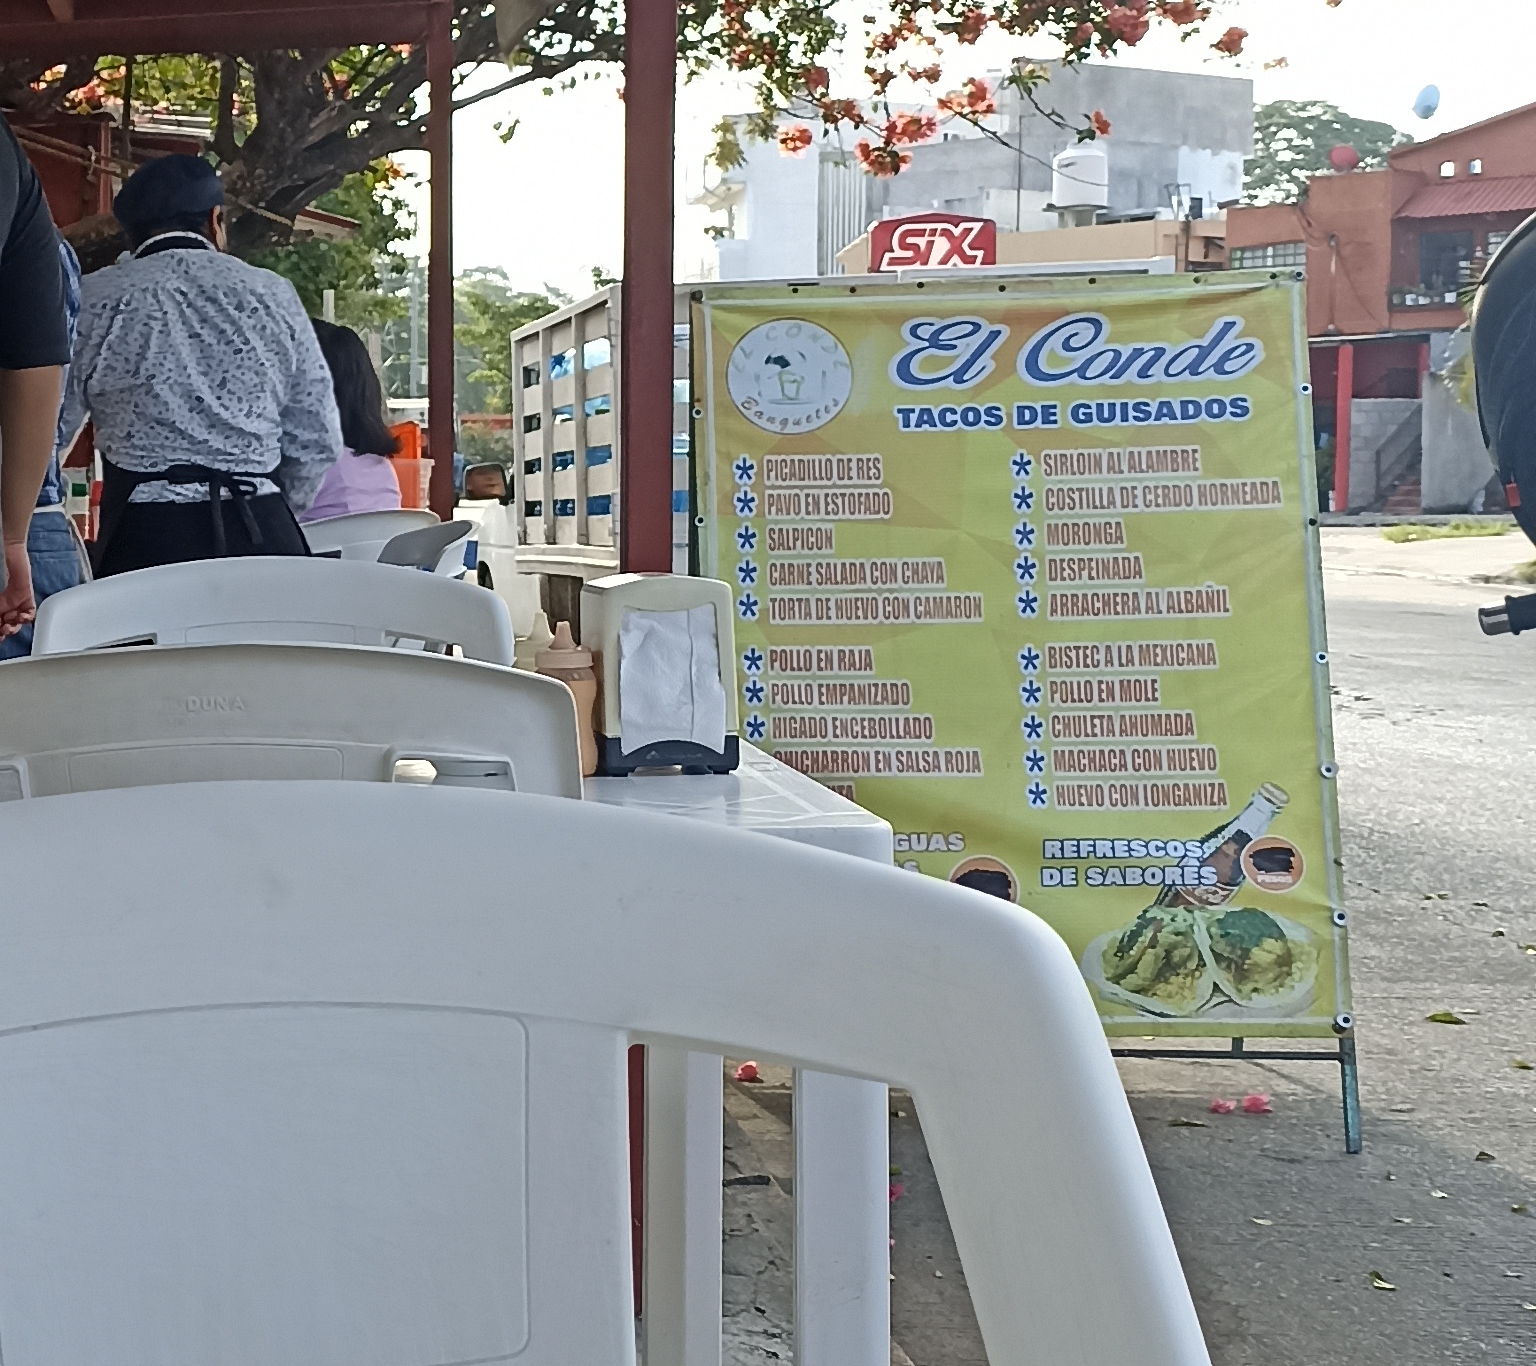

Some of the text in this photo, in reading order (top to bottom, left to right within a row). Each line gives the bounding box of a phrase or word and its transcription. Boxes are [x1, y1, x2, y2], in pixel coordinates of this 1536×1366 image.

[895, 316, 1258, 386] El Conde
[896, 396, 1250, 429] TACOS DE GUISADOS
[766, 456, 882, 482] PICADILLO DE RES
[1043, 448, 1199, 477] SIRLOIN AL ALAMBRE
[767, 491, 891, 516] PAVO EN ESTOFADO
[1045, 480, 1282, 512] COSTILLA DE CERDO HORNEADA
[768, 527, 833, 551] SALPICON
[1046, 521, 1125, 546] MORONGA
[769, 560, 945, 586] CARNE SALADA CON CHAYA
[1048, 555, 1143, 582] DESPEINADA
[770, 595, 983, 621] TORTA DE HUEVO CON CAMARON
[1050, 584, 1230, 617] ARRACHERA AL ALBAÑIL
[769, 648, 874, 672] POLLO EN RAJA
[1048, 642, 1217, 669] BISTEC A LA MEXICANA
[186, 695, 246, 713] DUNA
[771, 683, 911, 706] POLLO EMPANIZADO
[1050, 678, 1159, 704] POLLO EN MOLE
[772, 716, 933, 740] HIGADO ENCEBOLLADO
[1051, 712, 1195, 739] CHULETA AHUMADA
[874, 750, 892, 773] EN
[895, 750, 942, 773] SALSA
[944, 750, 981, 773] ROJA
[1053, 747, 1217, 773] MACHACA CON HUEVO
[1056, 782, 1228, 808] HUEVO CON LONGANIZA
[894, 832, 965, 852] GUAS
[1043, 838, 1204, 859] REFRESCOS
[1041, 865, 1219, 887] DE SABORES
